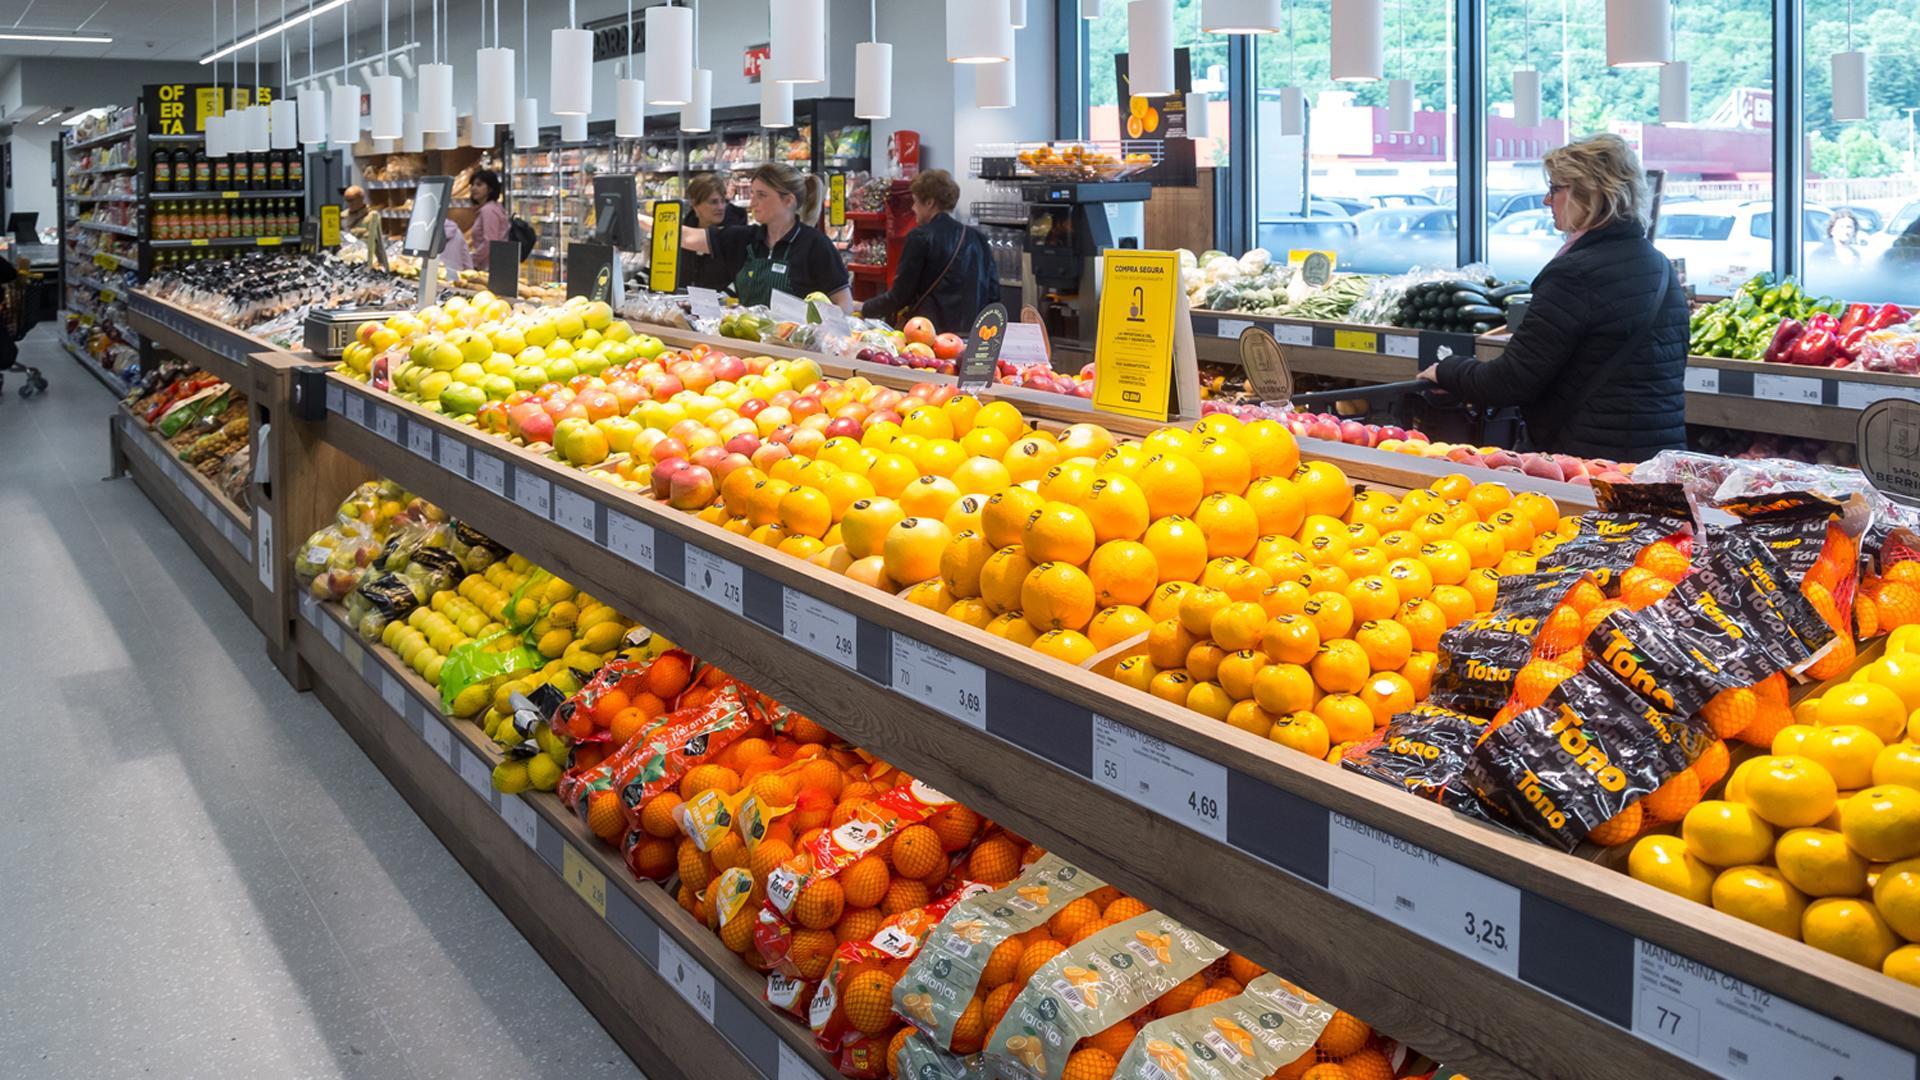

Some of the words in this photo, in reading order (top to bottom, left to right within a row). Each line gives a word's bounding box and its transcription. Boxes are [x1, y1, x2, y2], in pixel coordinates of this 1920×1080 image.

[159, 85, 185, 101] OF
[160, 103, 185, 118] ER
[159, 119, 185, 135] TA
[1114, 264, 1139, 273] COMPRA
[1140, 266, 1164, 274] SEGURA
[1876, 472, 1920, 489] BERRI
[724, 582, 740, 602] 2,75
[900, 668, 910, 686] 70
[1466, 660, 1511, 681] Tono
[1095, 714, 1137, 740] CLEMENTINA
[1549, 703, 1627, 792] Tono
[1104, 759, 1118, 780] 55
[1515, 769, 1566, 829] Tono
[1333, 813, 1391, 847] CLEMENTINA
[1392, 836, 1425, 860] BOLSA
[1426, 853, 1440, 867] 1K
[769, 874, 794, 900] Torres
[1641, 941, 1718, 985] MANDARINA
[914, 967, 958, 1001] Naranjas
[1019, 1006, 1063, 1048] Naranjas
[1657, 1006, 1682, 1035] 77
